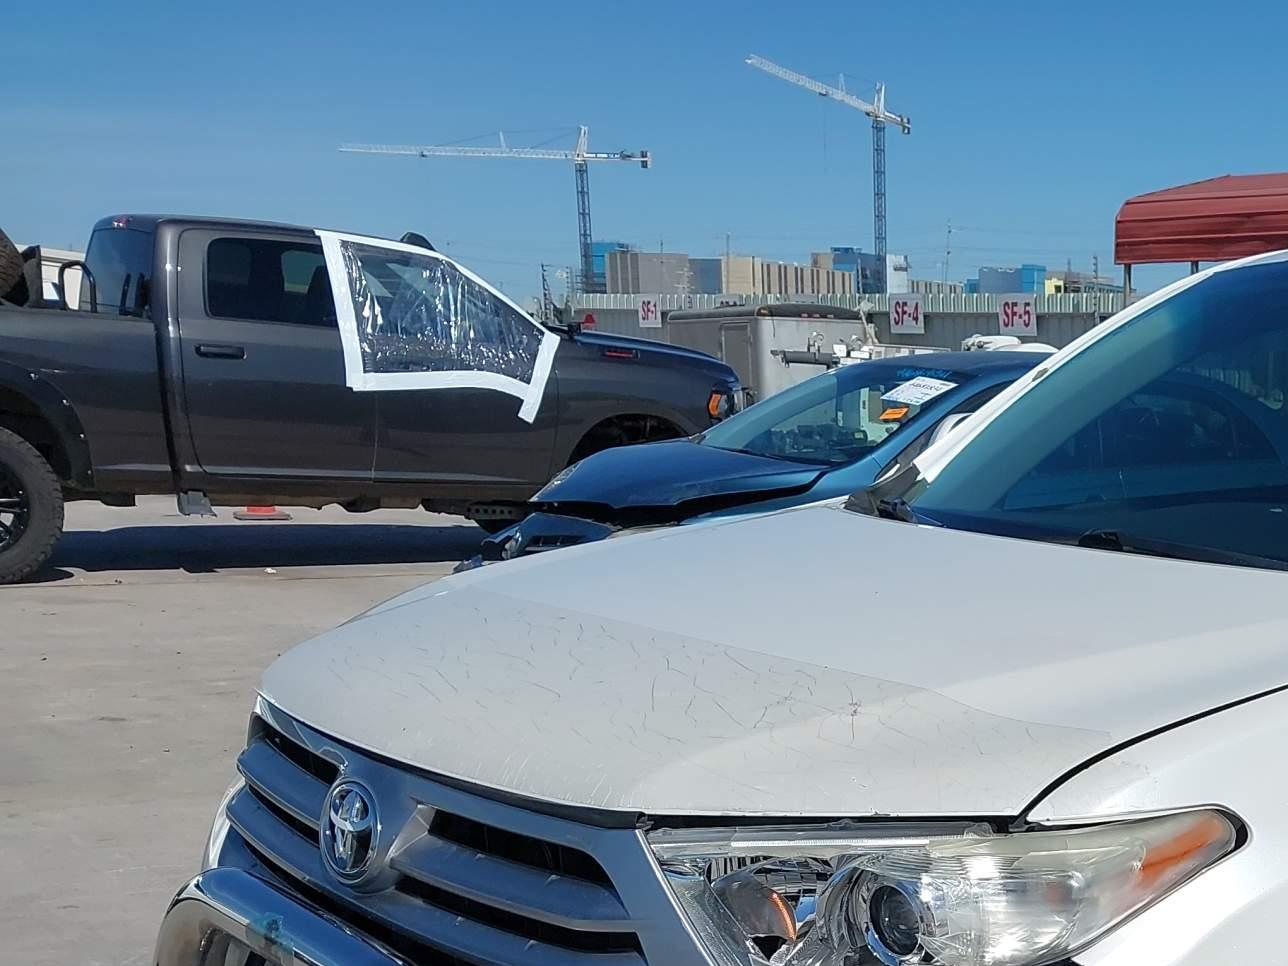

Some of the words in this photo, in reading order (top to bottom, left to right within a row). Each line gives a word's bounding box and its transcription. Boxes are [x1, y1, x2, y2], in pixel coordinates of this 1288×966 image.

[641, 300, 657, 321] SF-1
[893, 301, 919, 326] SF-4
[1002, 302, 1031, 327] SF-5
